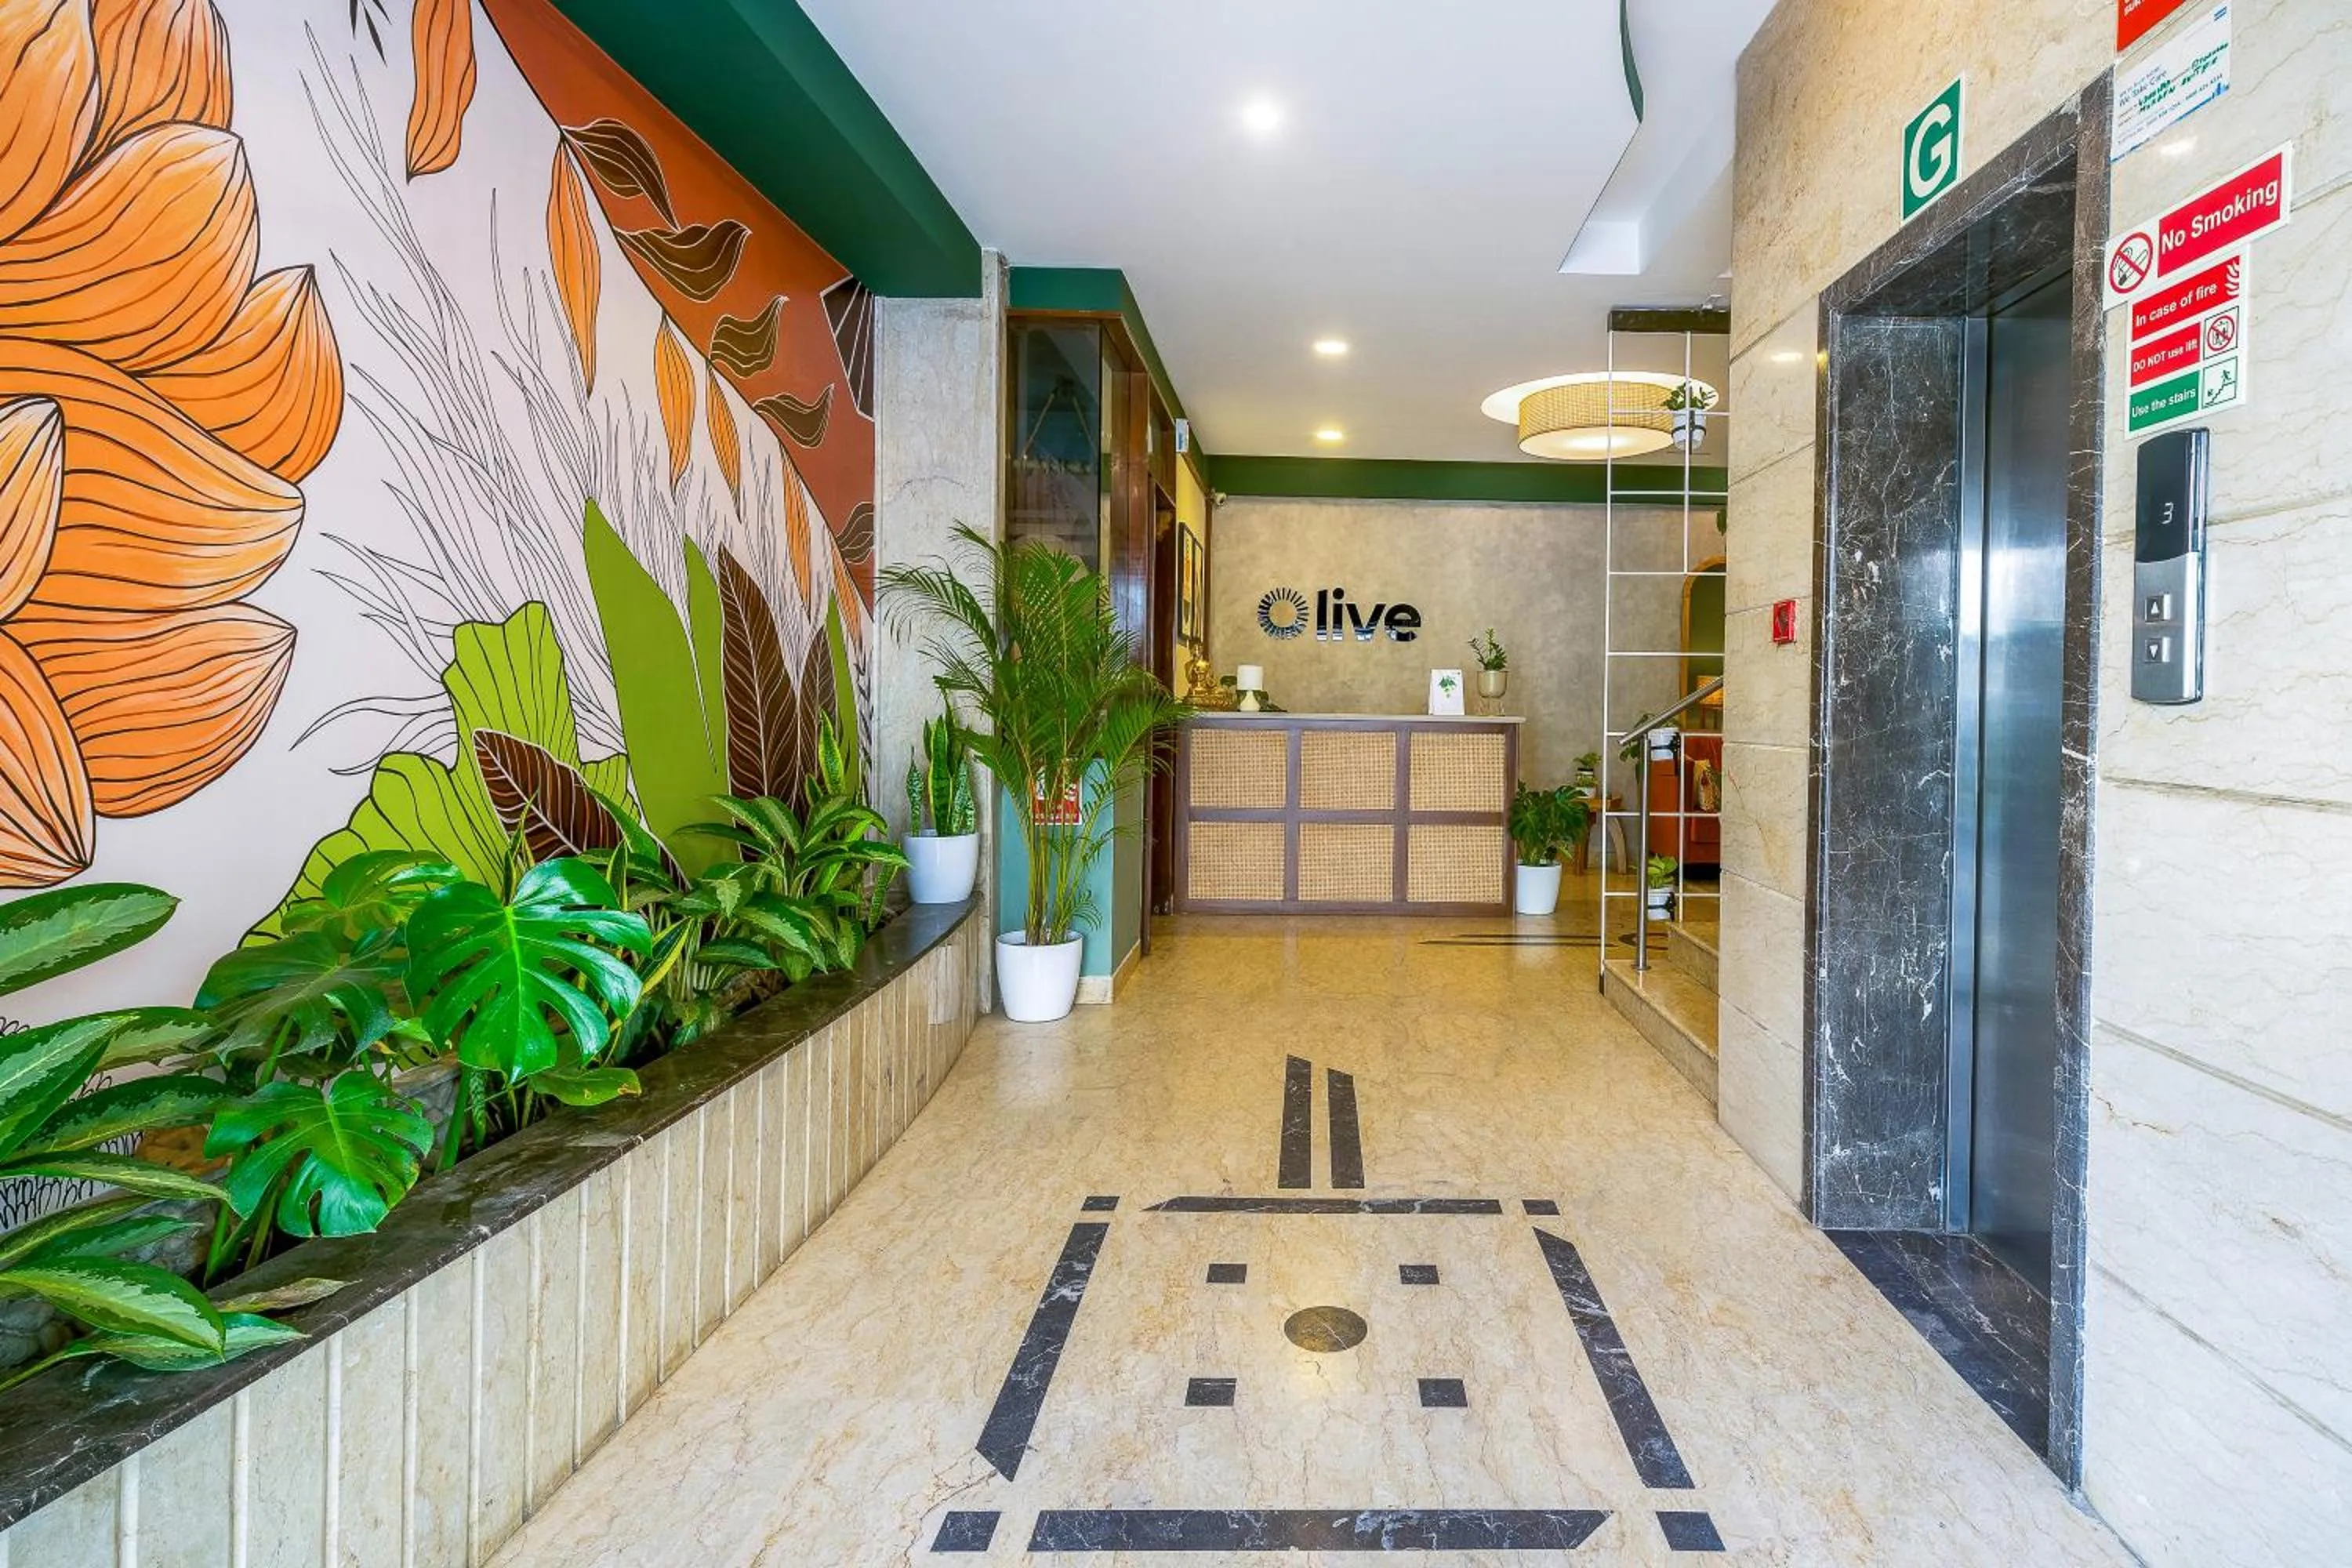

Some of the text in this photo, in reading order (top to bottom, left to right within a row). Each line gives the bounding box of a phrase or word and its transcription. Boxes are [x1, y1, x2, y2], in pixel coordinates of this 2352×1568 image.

[1909, 103, 1952, 198] G
[2161, 180, 2278, 255] No Smoking
[2135, 283, 2218, 326] In case of fire
[2132, 339, 2198, 372] DO NOT use lift
[2132, 389, 2196, 418] Use the stairs
[2161, 502, 2174, 524] 3
